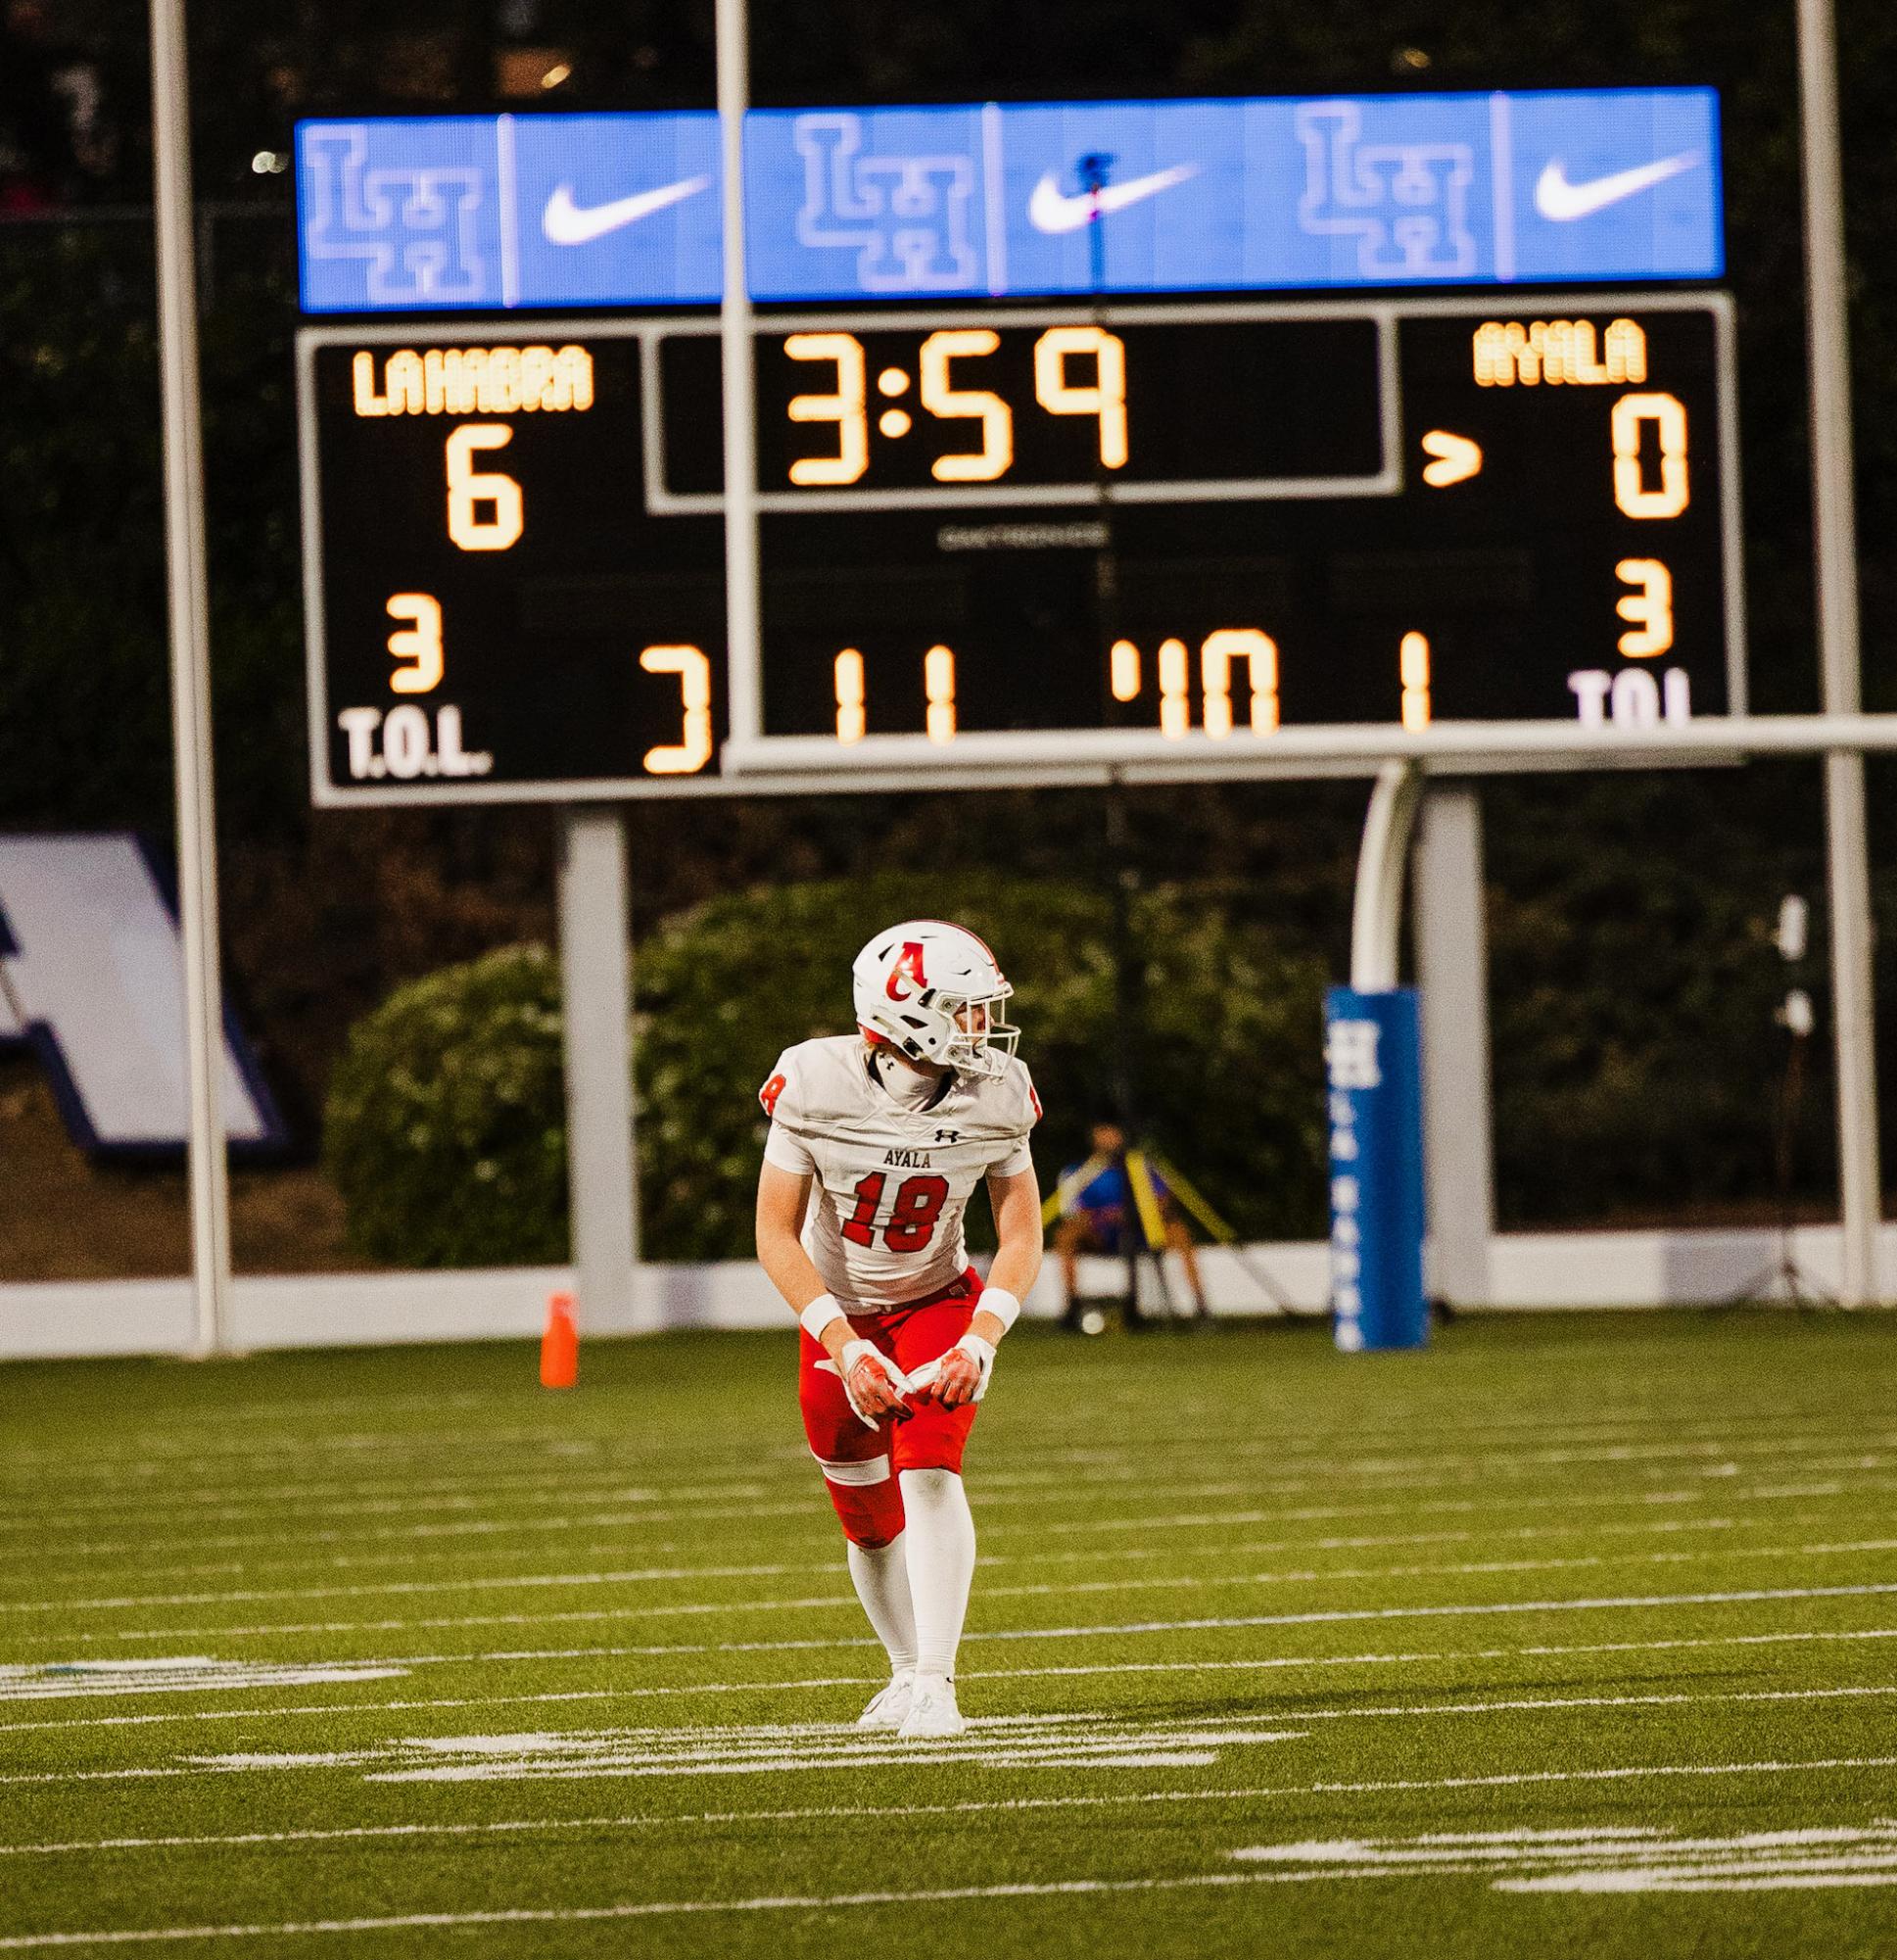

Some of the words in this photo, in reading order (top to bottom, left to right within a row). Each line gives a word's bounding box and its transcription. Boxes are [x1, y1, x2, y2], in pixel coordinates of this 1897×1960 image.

[1474, 319, 1646, 386] AYALA
[784, 327, 1127, 485] 3:59
[447, 424, 523, 550] 6
[1612, 393, 1688, 518] 0
[387, 594, 443, 693] 3
[1616, 559, 1673, 657] 3
[341, 707, 493, 779] T.O.L.
[886, 941, 928, 1002] A
[883, 1150, 930, 1169] AYALA
[841, 1171, 950, 1253] 18
